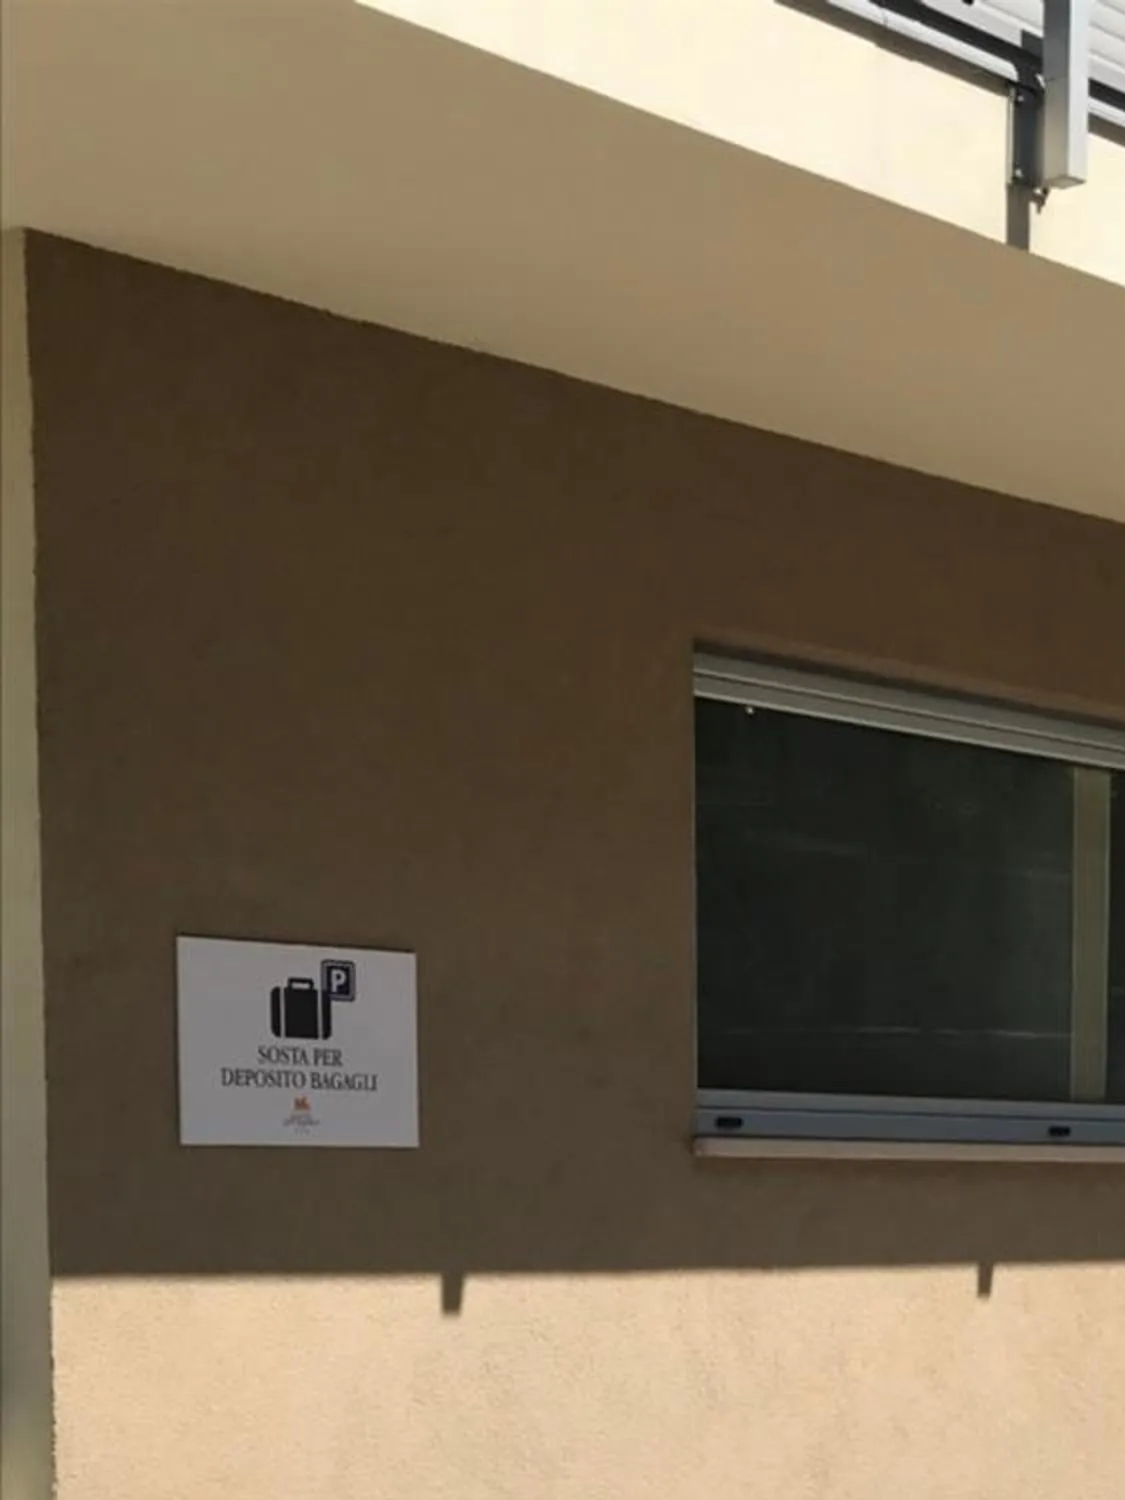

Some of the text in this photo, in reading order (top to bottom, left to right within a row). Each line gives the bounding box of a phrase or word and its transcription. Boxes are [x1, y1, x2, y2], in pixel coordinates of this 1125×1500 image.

[331, 969, 347, 993] P
[257, 1045, 343, 1067] SOSTA PER
[220, 1067, 378, 1091] DEPOSITO BAGAGLI
